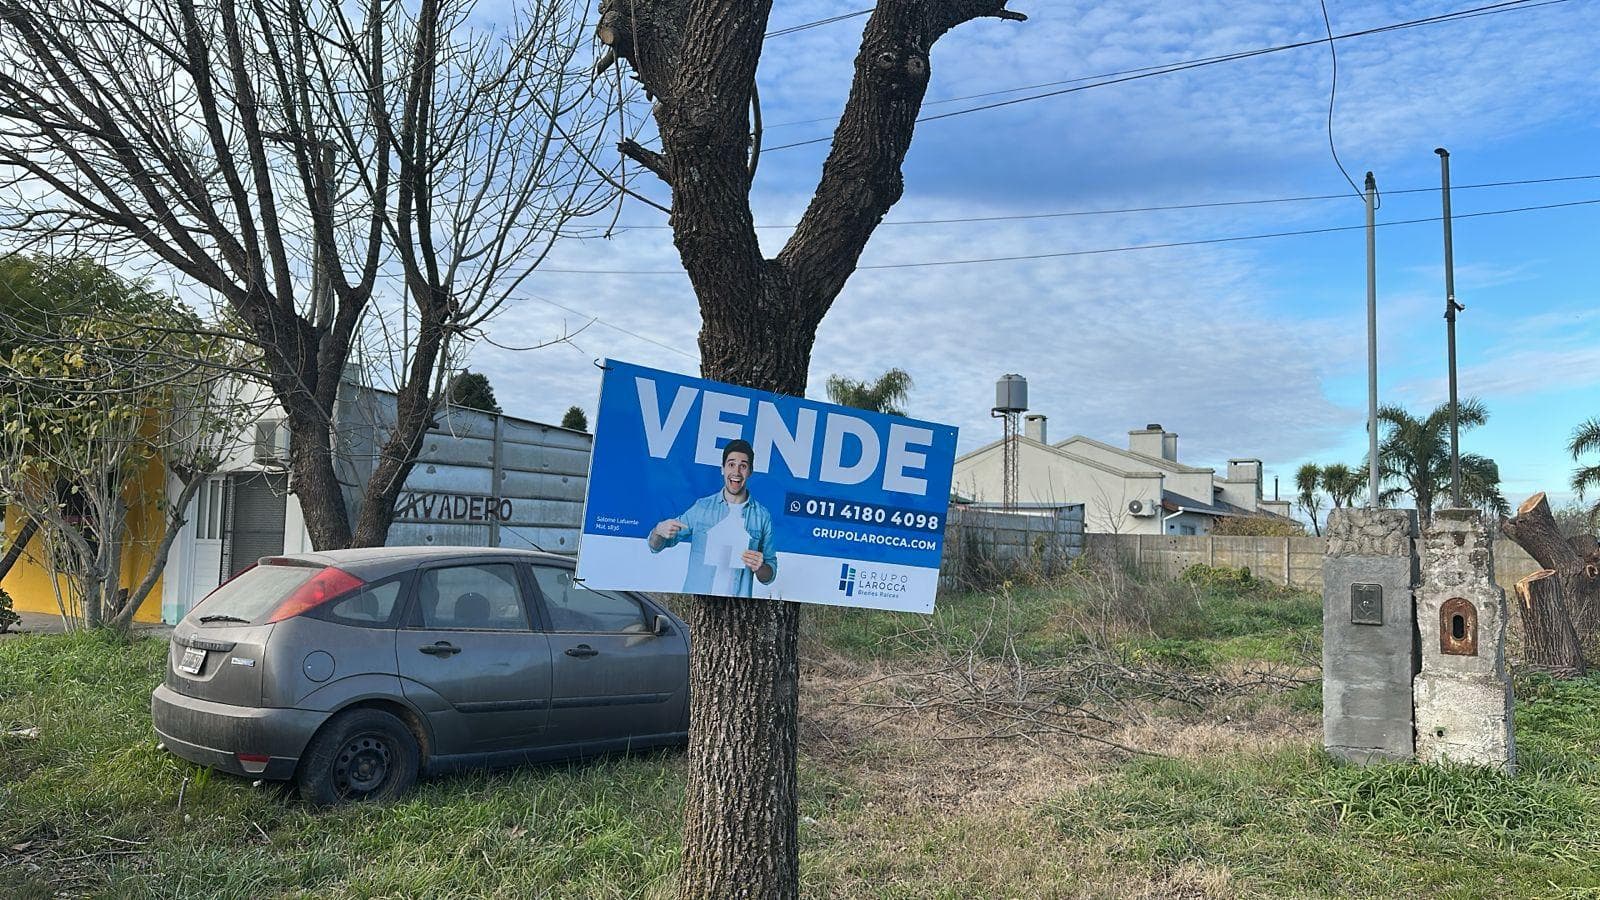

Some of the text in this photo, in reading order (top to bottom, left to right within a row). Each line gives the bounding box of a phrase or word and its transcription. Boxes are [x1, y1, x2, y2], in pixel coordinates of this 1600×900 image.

[635, 376, 934, 496] VENDE
[394, 493, 512, 521] AVADERO
[806, 500, 939, 530] 011 4180 4098
[812, 527, 937, 551] GRUPOLAROCCA.COM
[859, 581, 906, 592] LAROCCA
[860, 571, 908, 583] GRUPO
